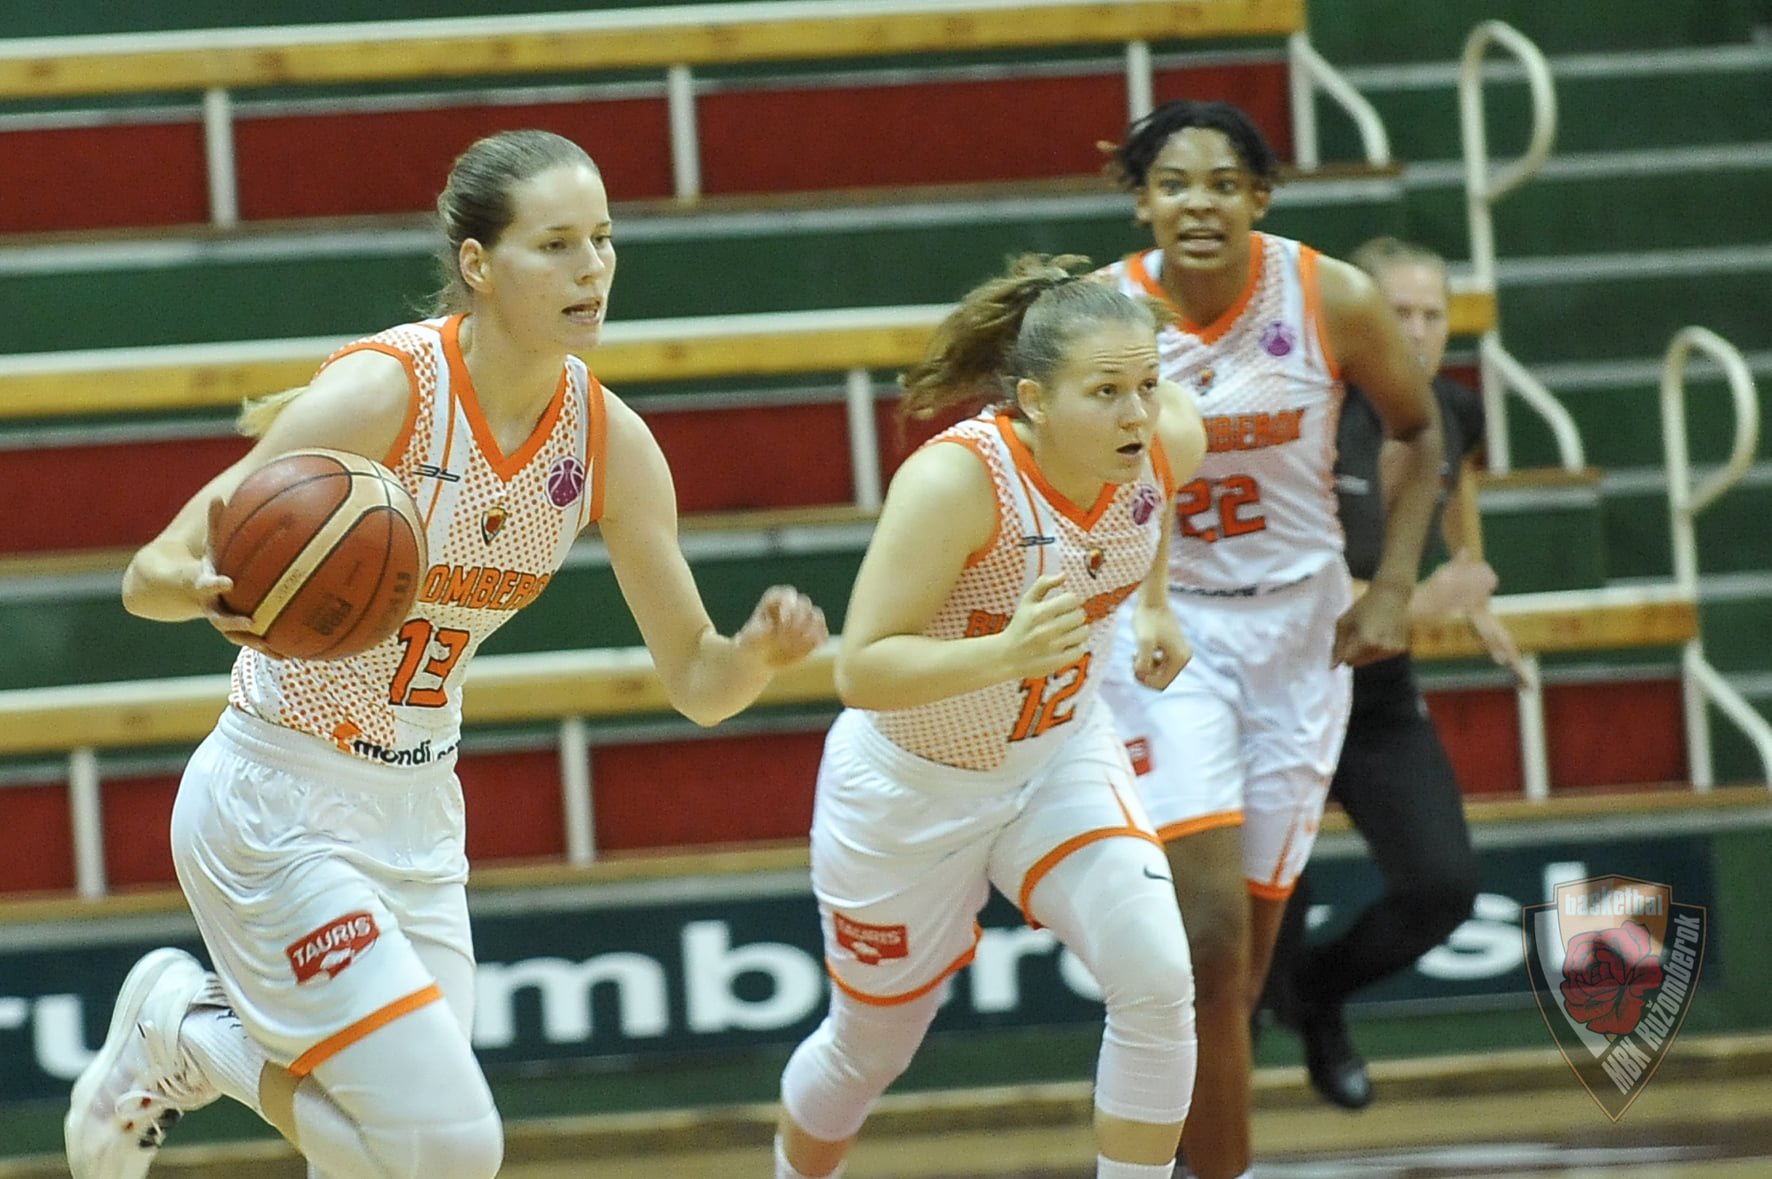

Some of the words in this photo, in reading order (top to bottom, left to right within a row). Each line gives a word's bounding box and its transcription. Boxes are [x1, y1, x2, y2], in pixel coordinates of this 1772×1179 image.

[1175, 474, 1266, 542] 22
[388, 618, 470, 708] 13
[1007, 652, 1092, 743] 12
[353, 739, 431, 766] mondi
